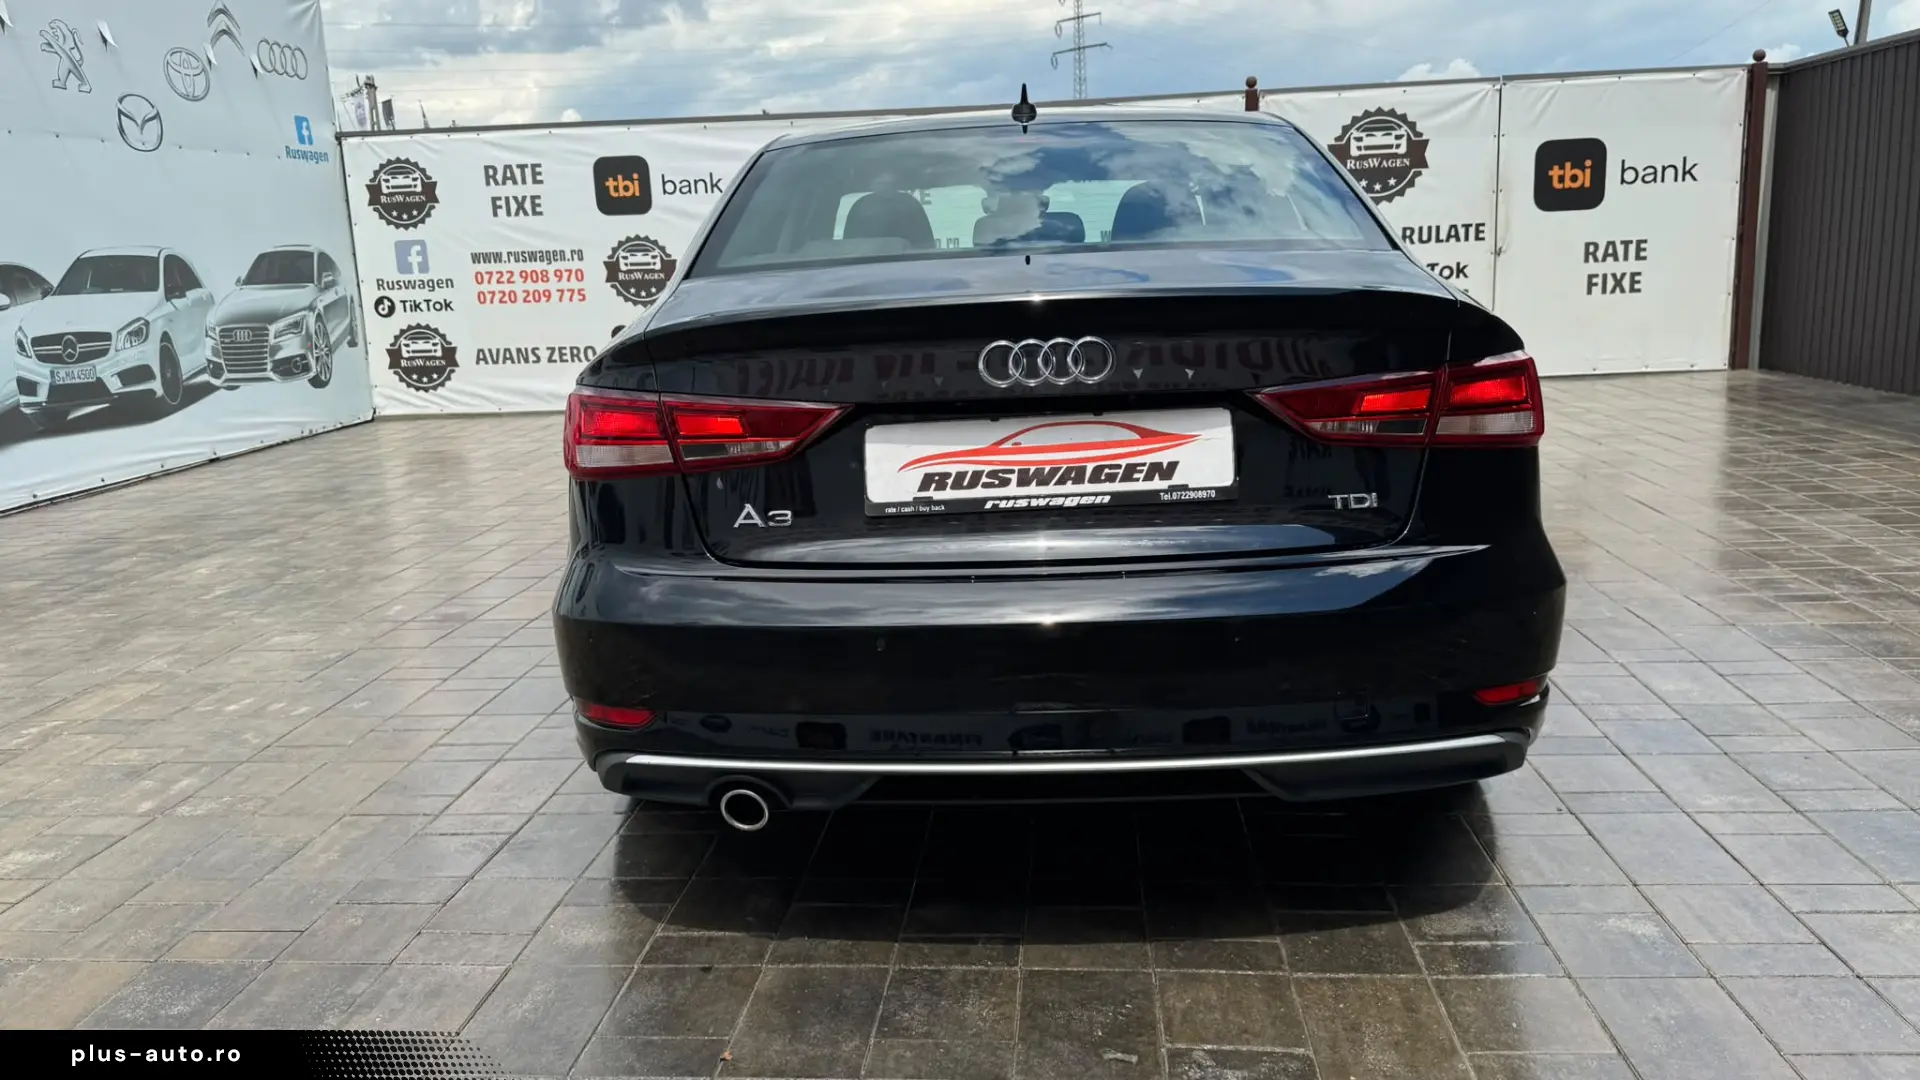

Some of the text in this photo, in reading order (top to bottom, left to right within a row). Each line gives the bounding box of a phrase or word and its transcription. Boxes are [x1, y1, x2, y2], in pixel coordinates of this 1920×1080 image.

[285, 145, 329, 164] Ruswagen
[483, 163, 544, 187] RATE
[1548, 159, 1592, 190] tbi
[1620, 157, 1698, 185] bank
[604, 174, 641, 197] tbi
[661, 173, 723, 196] bank
[491, 194, 544, 218] FIXE
[1401, 222, 1486, 245] RULATE
[471, 249, 584, 267] www.ruswagen.ro
[1583, 239, 1648, 263] RATE
[376, 276, 455, 293] Ruswagen
[474, 268, 585, 285] 0722 908 970
[1586, 272, 1642, 295] FIXE
[401, 298, 455, 315] TikTok
[477, 288, 587, 305] 0720 209 775
[475, 345, 597, 366] AVANS ZERO
[917, 460, 1179, 492] RUSWAGEN
[984, 494, 1111, 510] ruswagen
[1159, 490, 1216, 501] Tel.0722908970
[1327, 492, 1378, 510] TDI
[733, 503, 792, 528] A3
[901, 505, 915, 513] cash
[919, 504, 930, 513] buy
[931, 503, 945, 511] back
